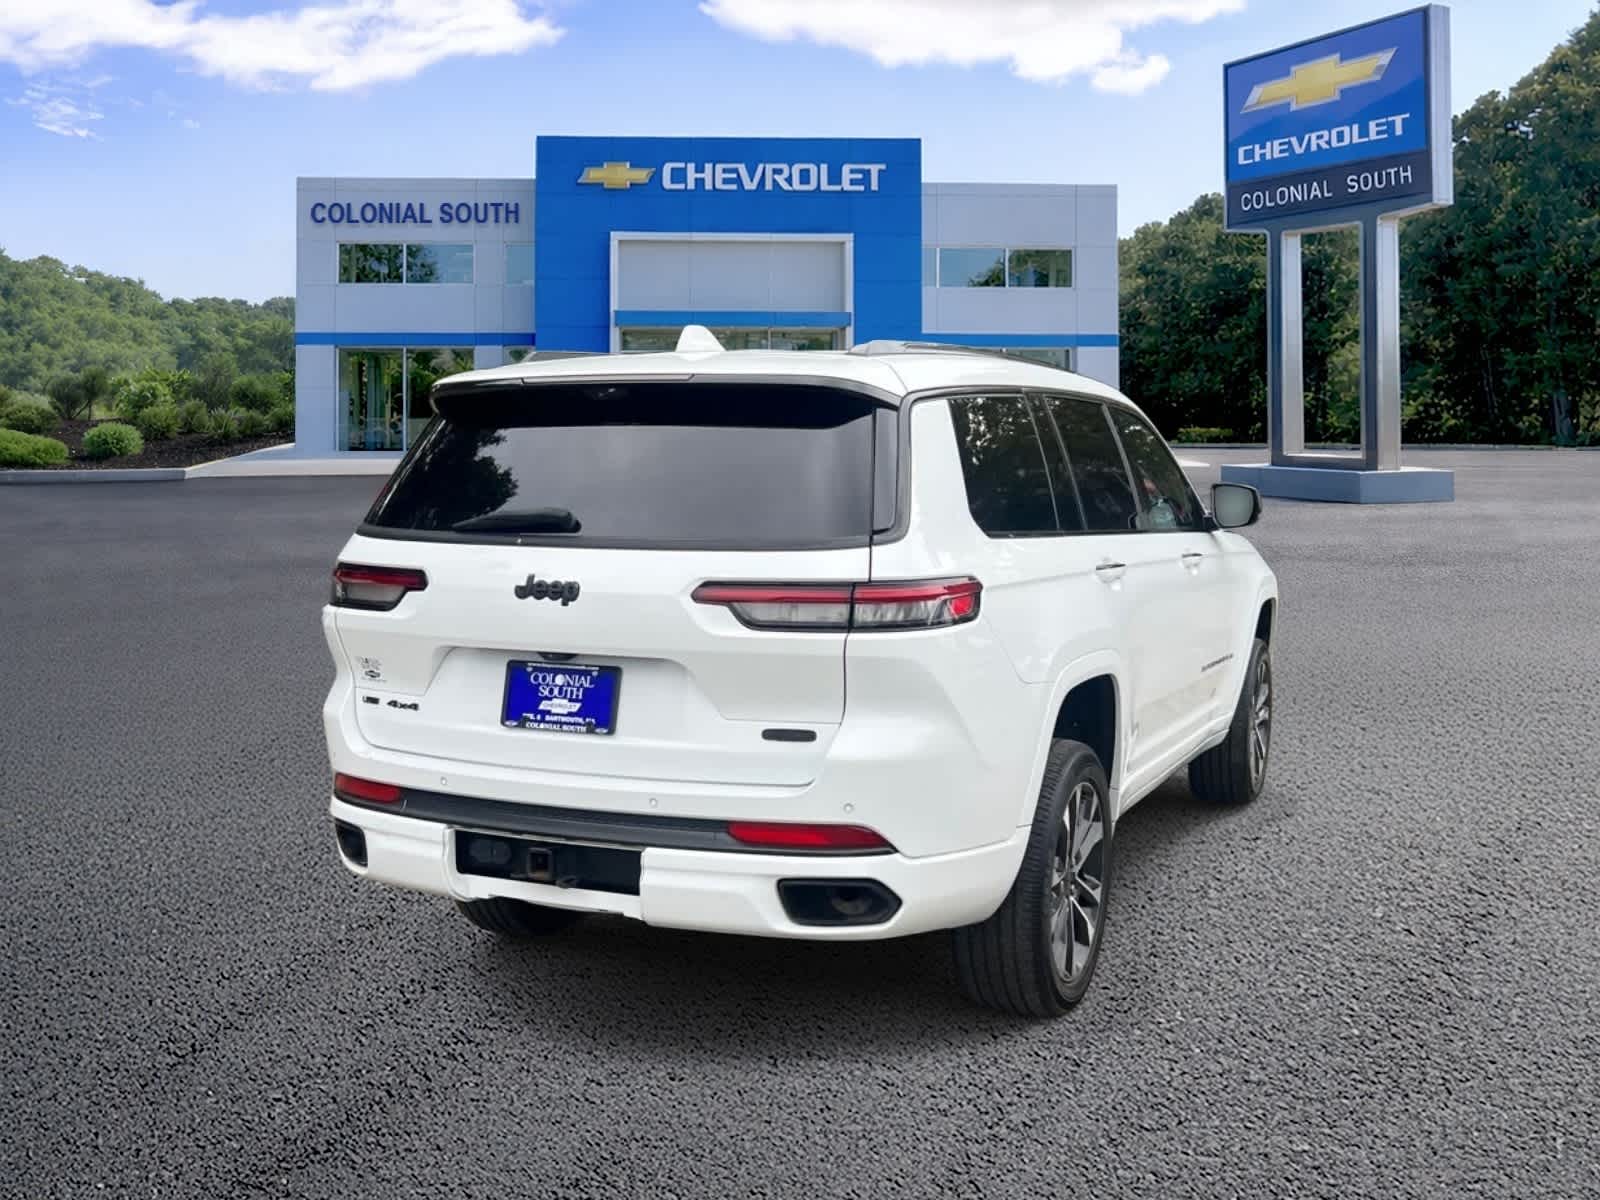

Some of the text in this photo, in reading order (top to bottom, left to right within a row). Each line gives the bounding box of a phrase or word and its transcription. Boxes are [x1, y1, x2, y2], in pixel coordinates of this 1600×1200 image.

[1237, 112, 1411, 166] CHEVROLET
[662, 161, 887, 192] CHEVROLET
[1240, 164, 1414, 212] COLONIAL SOUTH
[310, 202, 521, 225] COLONIAL SOUTH
[514, 573, 580, 607] Jeep
[530, 672, 594, 688] COLONIAL
[538, 685, 583, 699] SOUTH
